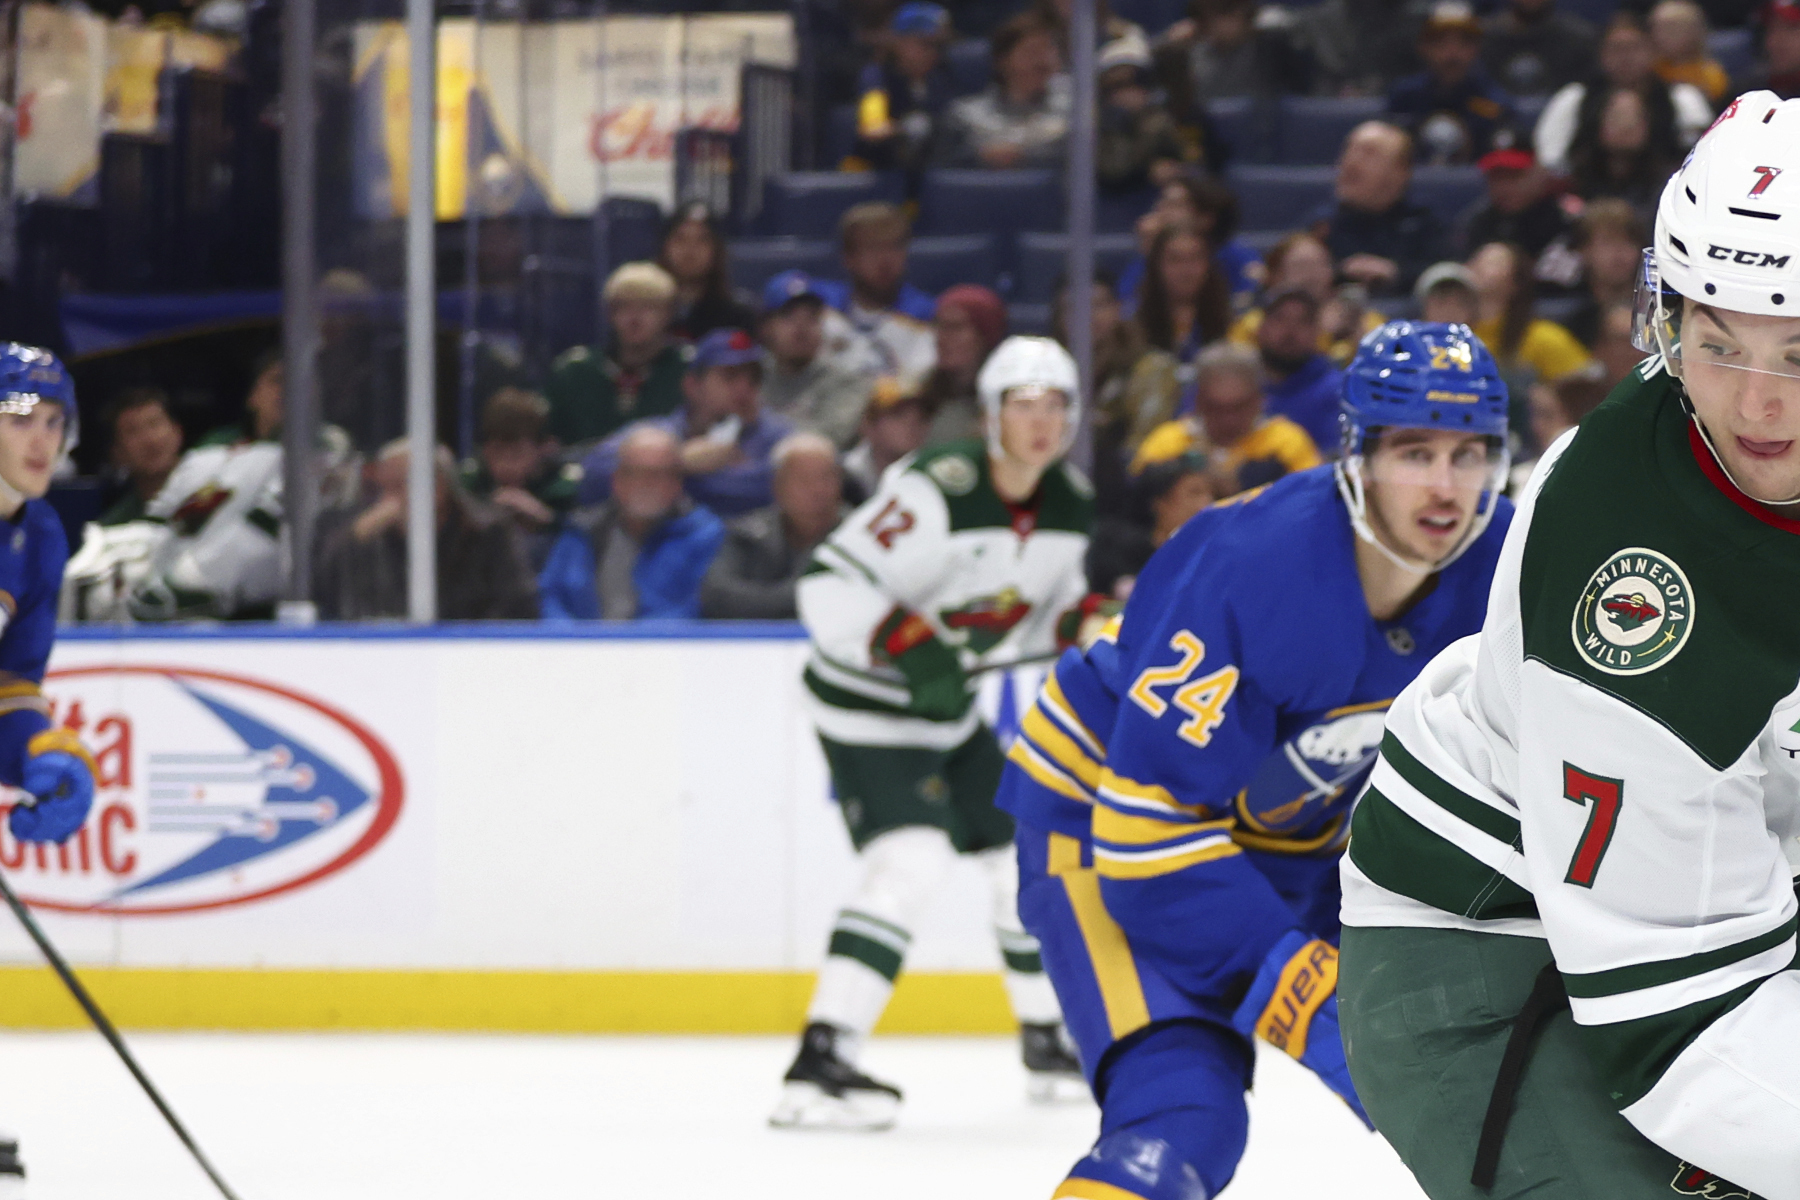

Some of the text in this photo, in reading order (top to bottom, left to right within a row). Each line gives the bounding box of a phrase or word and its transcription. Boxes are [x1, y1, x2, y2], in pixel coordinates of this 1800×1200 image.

[1748, 166, 1782, 199] 7
[1707, 243, 1792, 268] CCM
[1596, 558, 1684, 621] MINNESOTA
[1585, 632, 1632, 666] WILD
[1127, 628, 1240, 749] 24
[1563, 760, 1624, 889] 7
